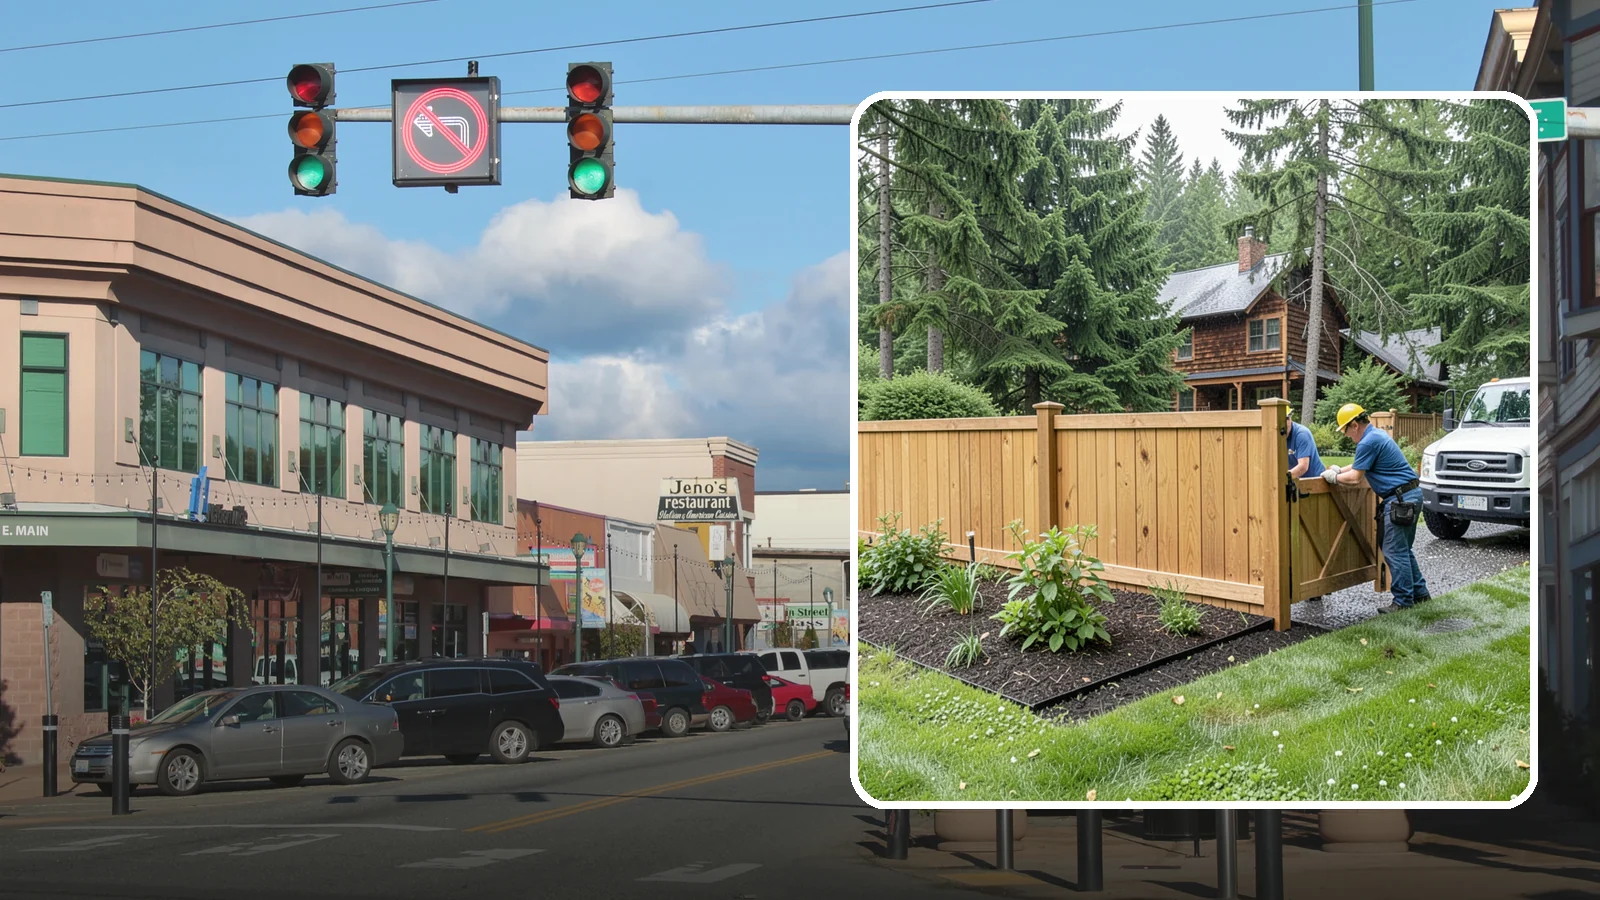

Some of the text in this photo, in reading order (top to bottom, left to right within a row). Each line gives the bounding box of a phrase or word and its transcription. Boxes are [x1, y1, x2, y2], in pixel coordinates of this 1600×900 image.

[669, 479, 727, 495] Jeno's
[665, 496, 731, 509] restaurant
[658, 509, 681, 519] Italian
[685, 509, 714, 519] American
[714, 509, 737, 519] Cuisine
[2, 525, 49, 536] E. MAIN
[797, 607, 828, 617] Street
